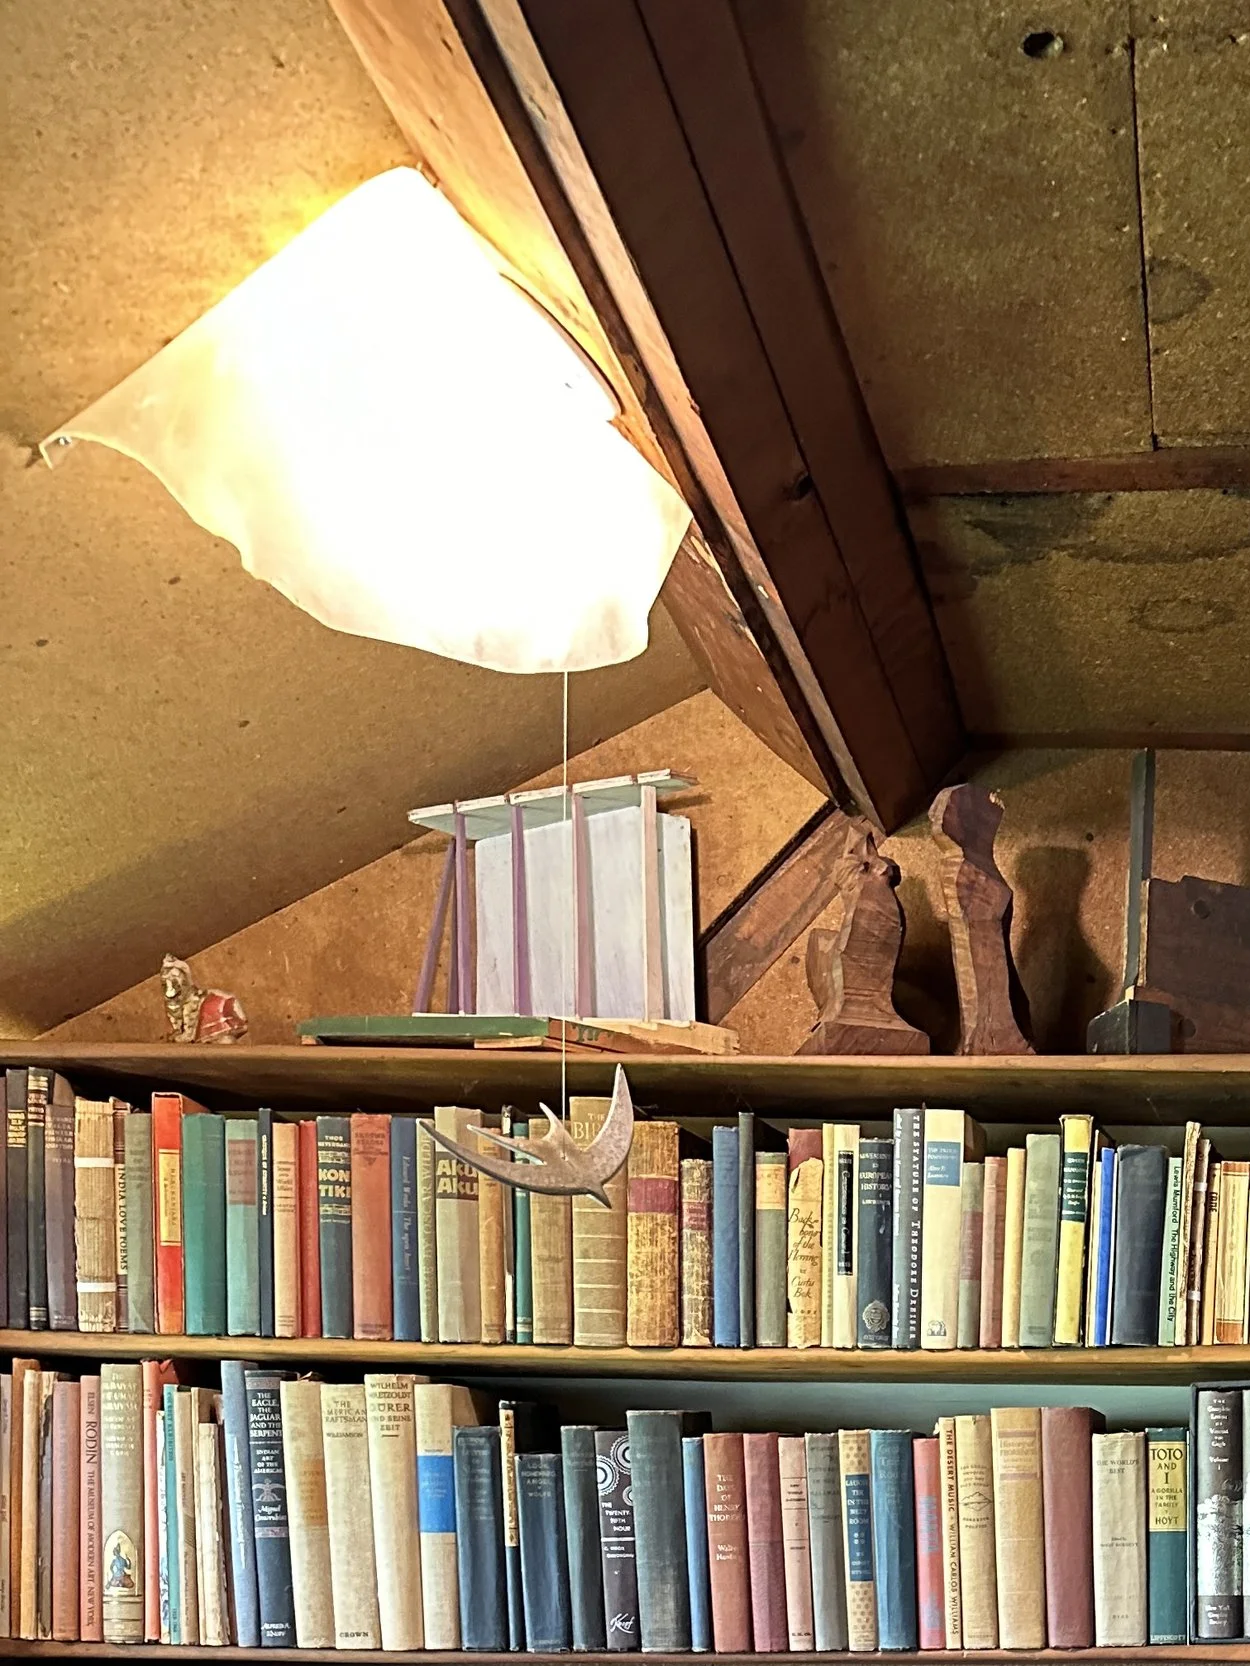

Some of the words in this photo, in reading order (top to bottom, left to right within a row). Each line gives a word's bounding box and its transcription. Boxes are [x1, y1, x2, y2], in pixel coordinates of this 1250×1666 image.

[912, 1115, 920, 1137] THE
[319, 1169, 350, 1182] KON
[912, 1141, 920, 1193] STATURE
[118, 1167, 126, 1201] INDIA
[1173, 1166, 1181, 1187] Lewis
[319, 1184, 351, 1198] TIKI
[912, 1197, 919, 1212] OF
[1171, 1189, 1180, 1223] Mumford
[119, 1203, 127, 1232] LOVE
[1171, 1229, 1179, 1242] The
[910, 1220, 921, 1283] THEODORE
[1168, 1244, 1178, 1275] Highway
[1168, 1277, 1176, 1291] and
[909, 1288, 919, 1340] DREISER
[1166, 1306, 1175, 1322] City
[334, 1400, 351, 1408] THE
[85, 1420, 98, 1465] RODIN
[1151, 1448, 1183, 1461] TOTO
[87, 1471, 95, 1486] THE
[1164, 1472, 1169, 1484] I
[87, 1487, 95, 1521] MUSEUM
[87, 1521, 95, 1531] OF
[1155, 1517, 1179, 1525] HOYT
[87, 1533, 95, 1567] MODERN
[87, 1568, 95, 1582] ART
[951, 1596, 959, 1634] WILLIAMS
